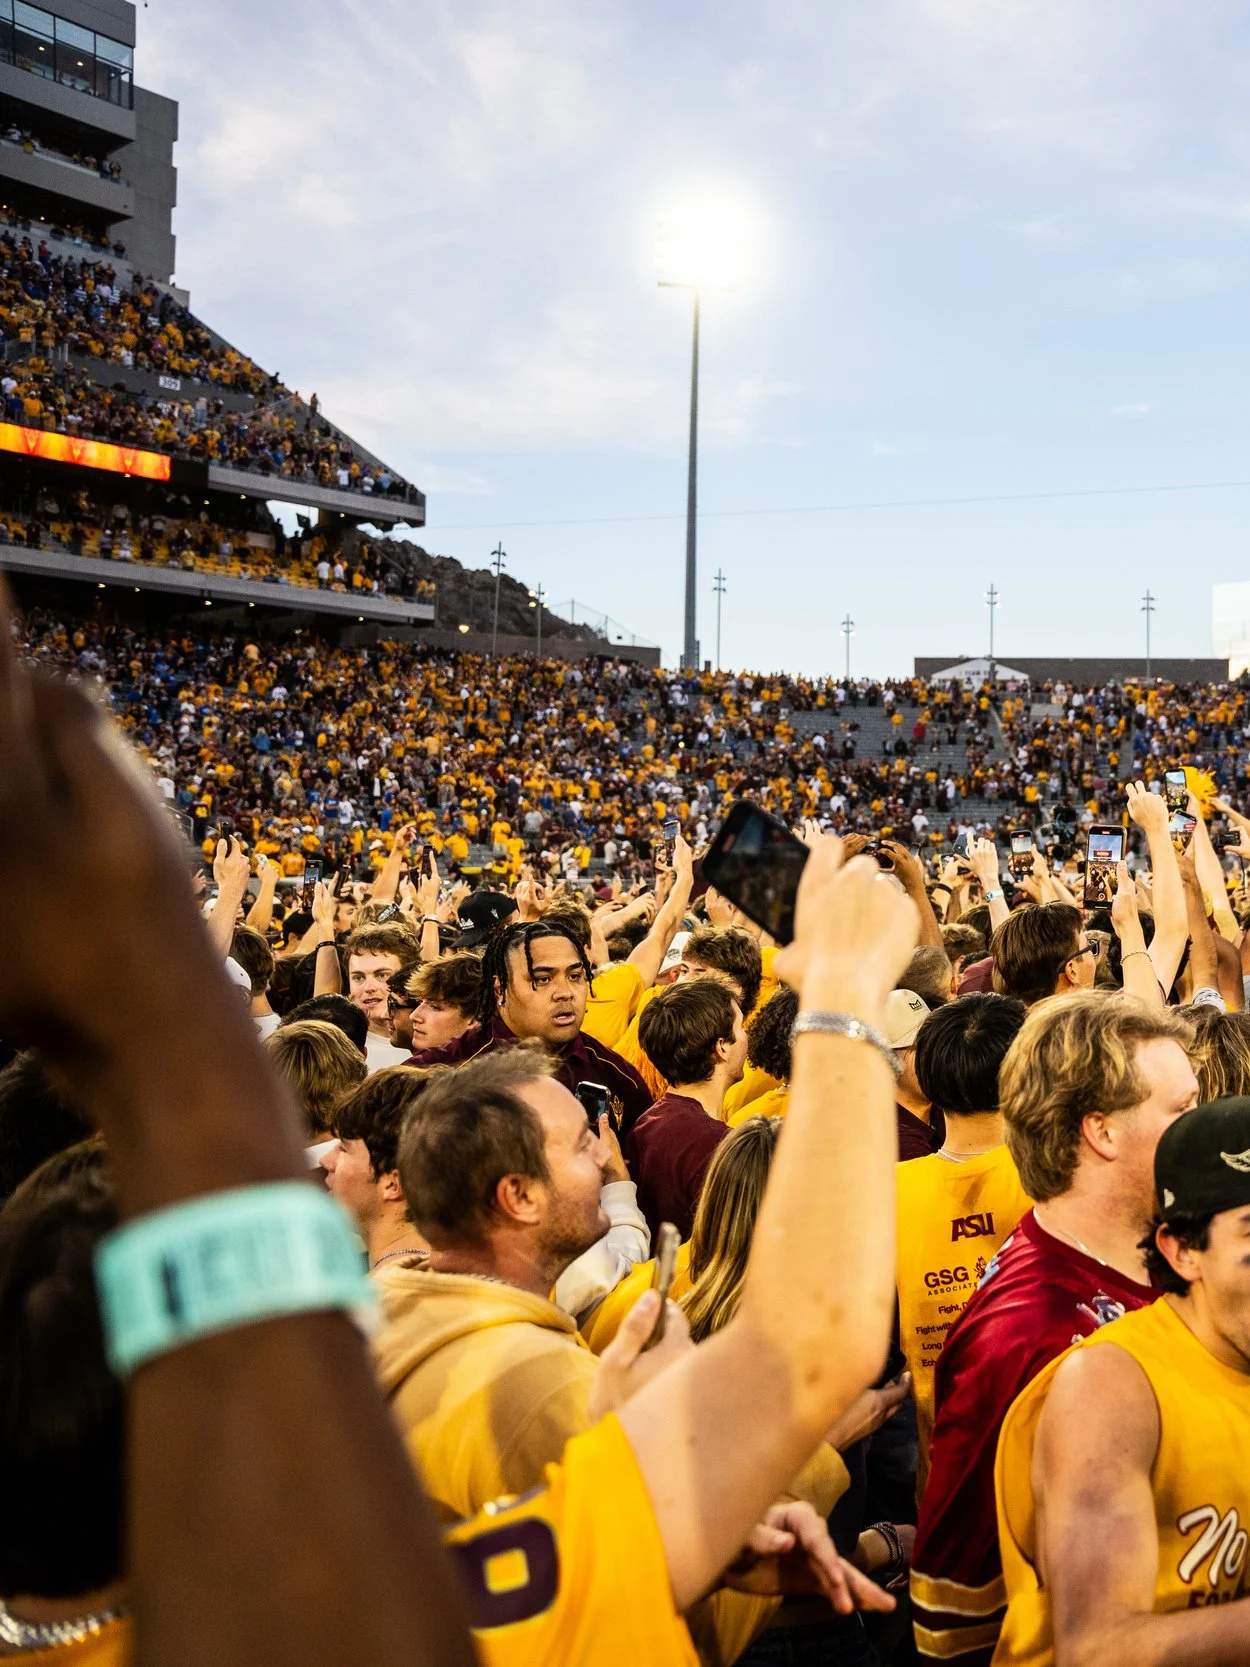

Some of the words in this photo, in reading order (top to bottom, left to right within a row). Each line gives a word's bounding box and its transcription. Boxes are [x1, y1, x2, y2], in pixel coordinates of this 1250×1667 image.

[951, 1212, 996, 1242] ASU
[924, 1265, 969, 1289] GSG
[927, 1282, 979, 1297] ASSOCIATE
[915, 1326, 937, 1335] Fight
[922, 1359, 937, 1367] Ech
[1177, 1504, 1248, 1588] No
